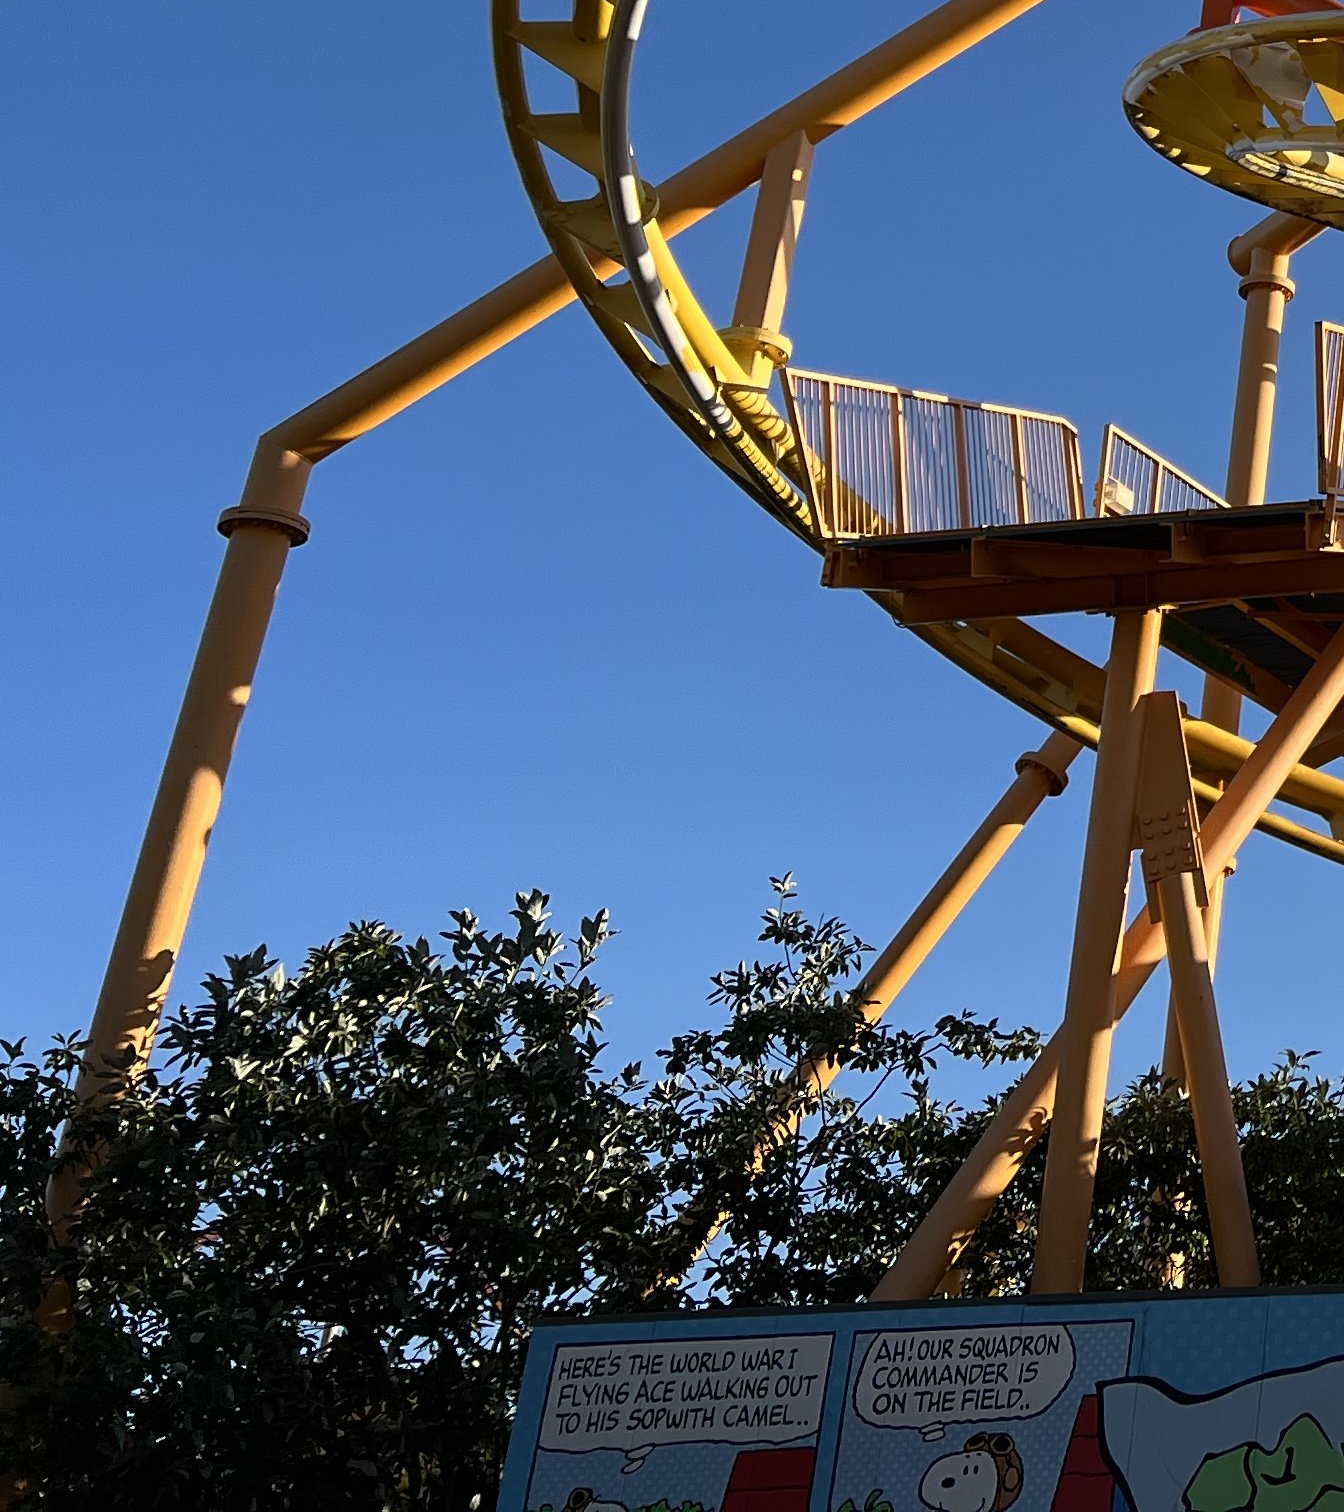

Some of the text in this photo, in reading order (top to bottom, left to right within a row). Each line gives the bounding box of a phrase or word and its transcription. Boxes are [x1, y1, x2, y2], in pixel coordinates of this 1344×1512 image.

[917, 1338, 954, 1361] OUR
[958, 1334, 1060, 1361] SQUADRON
[558, 1348, 799, 1381] HERE'S THE WORLD WAR I
[872, 1361, 1039, 1390] COMMANDER IS
[557, 1374, 819, 1408] FLYING ACE WALKING OUT
[872, 1392, 907, 1415] ON
[914, 1390, 956, 1413] THE
[555, 1412, 581, 1435] TO
[585, 1409, 619, 1433] HIS
[625, 1406, 716, 1431] SOPWITH
